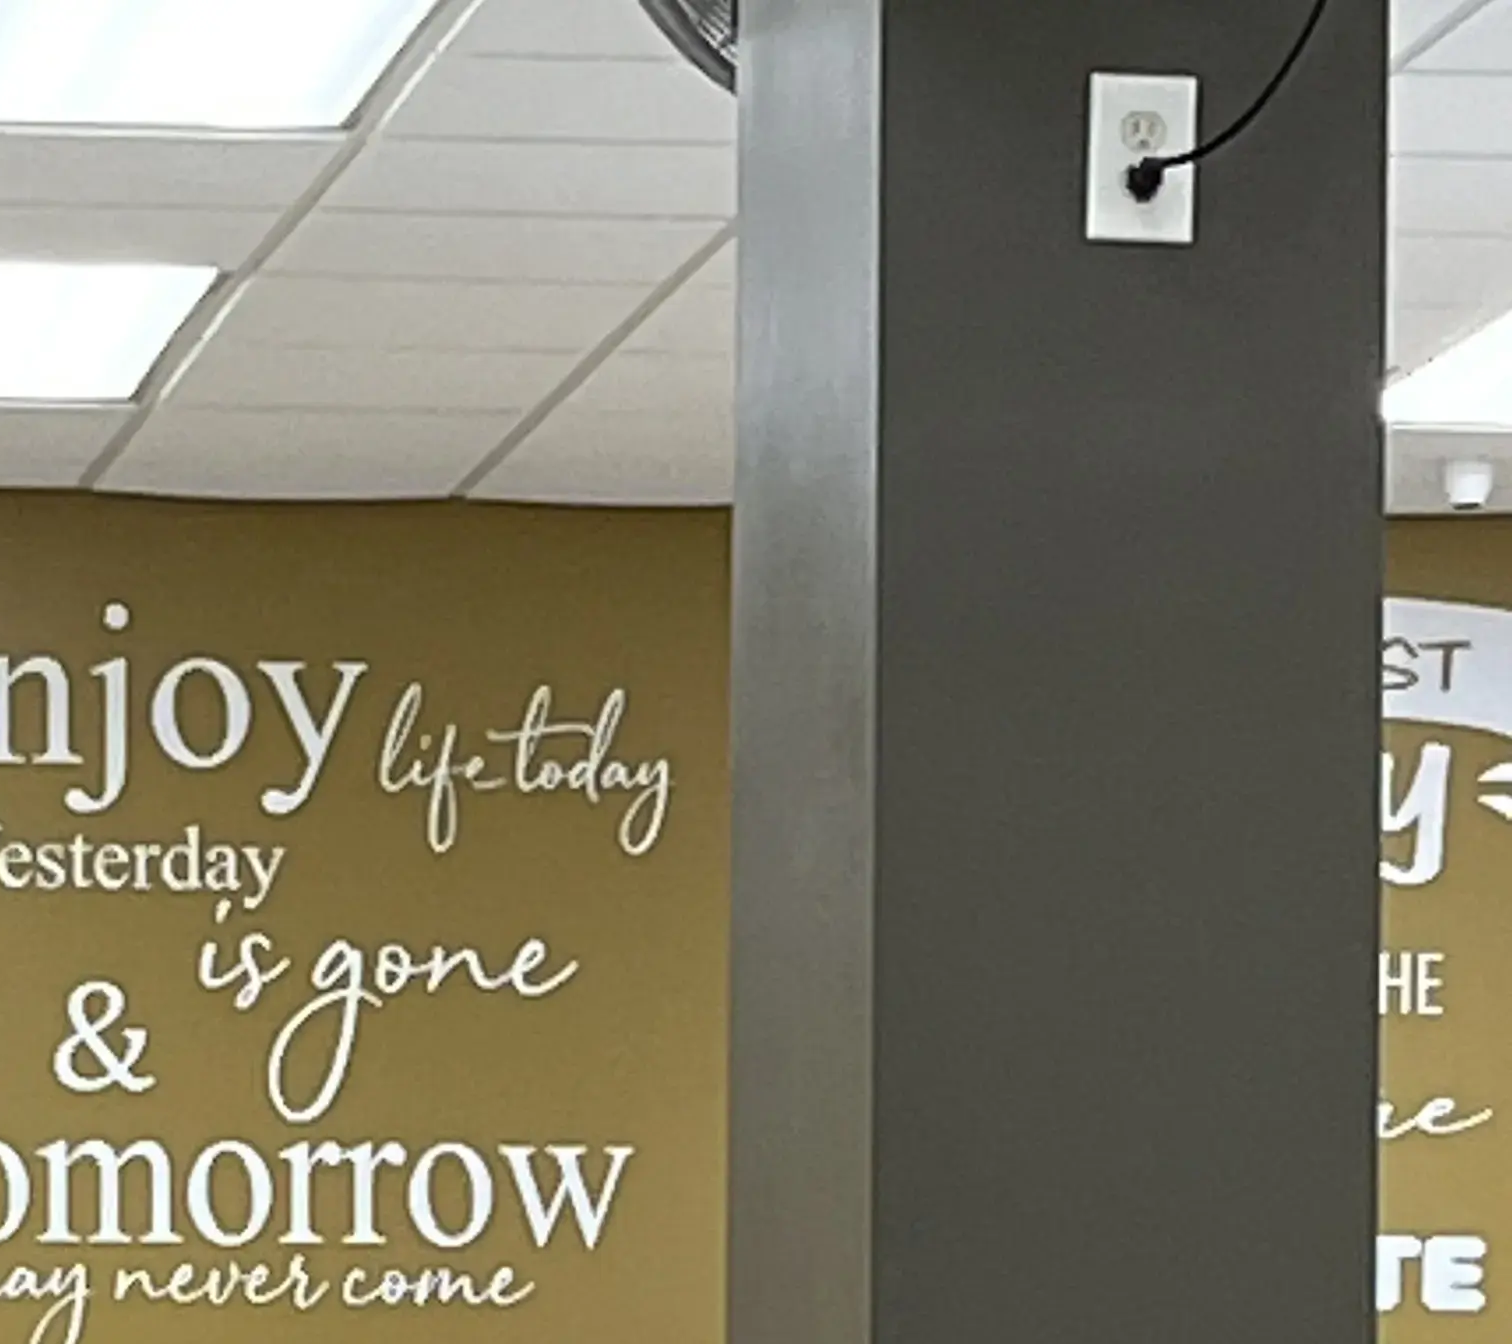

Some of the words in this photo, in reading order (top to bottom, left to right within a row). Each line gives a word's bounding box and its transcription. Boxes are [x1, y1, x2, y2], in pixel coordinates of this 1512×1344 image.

[379, 682, 506, 853] life
[486, 684, 672, 856] today
[52, 980, 158, 1094] &
[198, 898, 291, 1010] is
[268, 937, 580, 1123] gone
[113, 1253, 330, 1310] never
[341, 1264, 535, 1307] come
